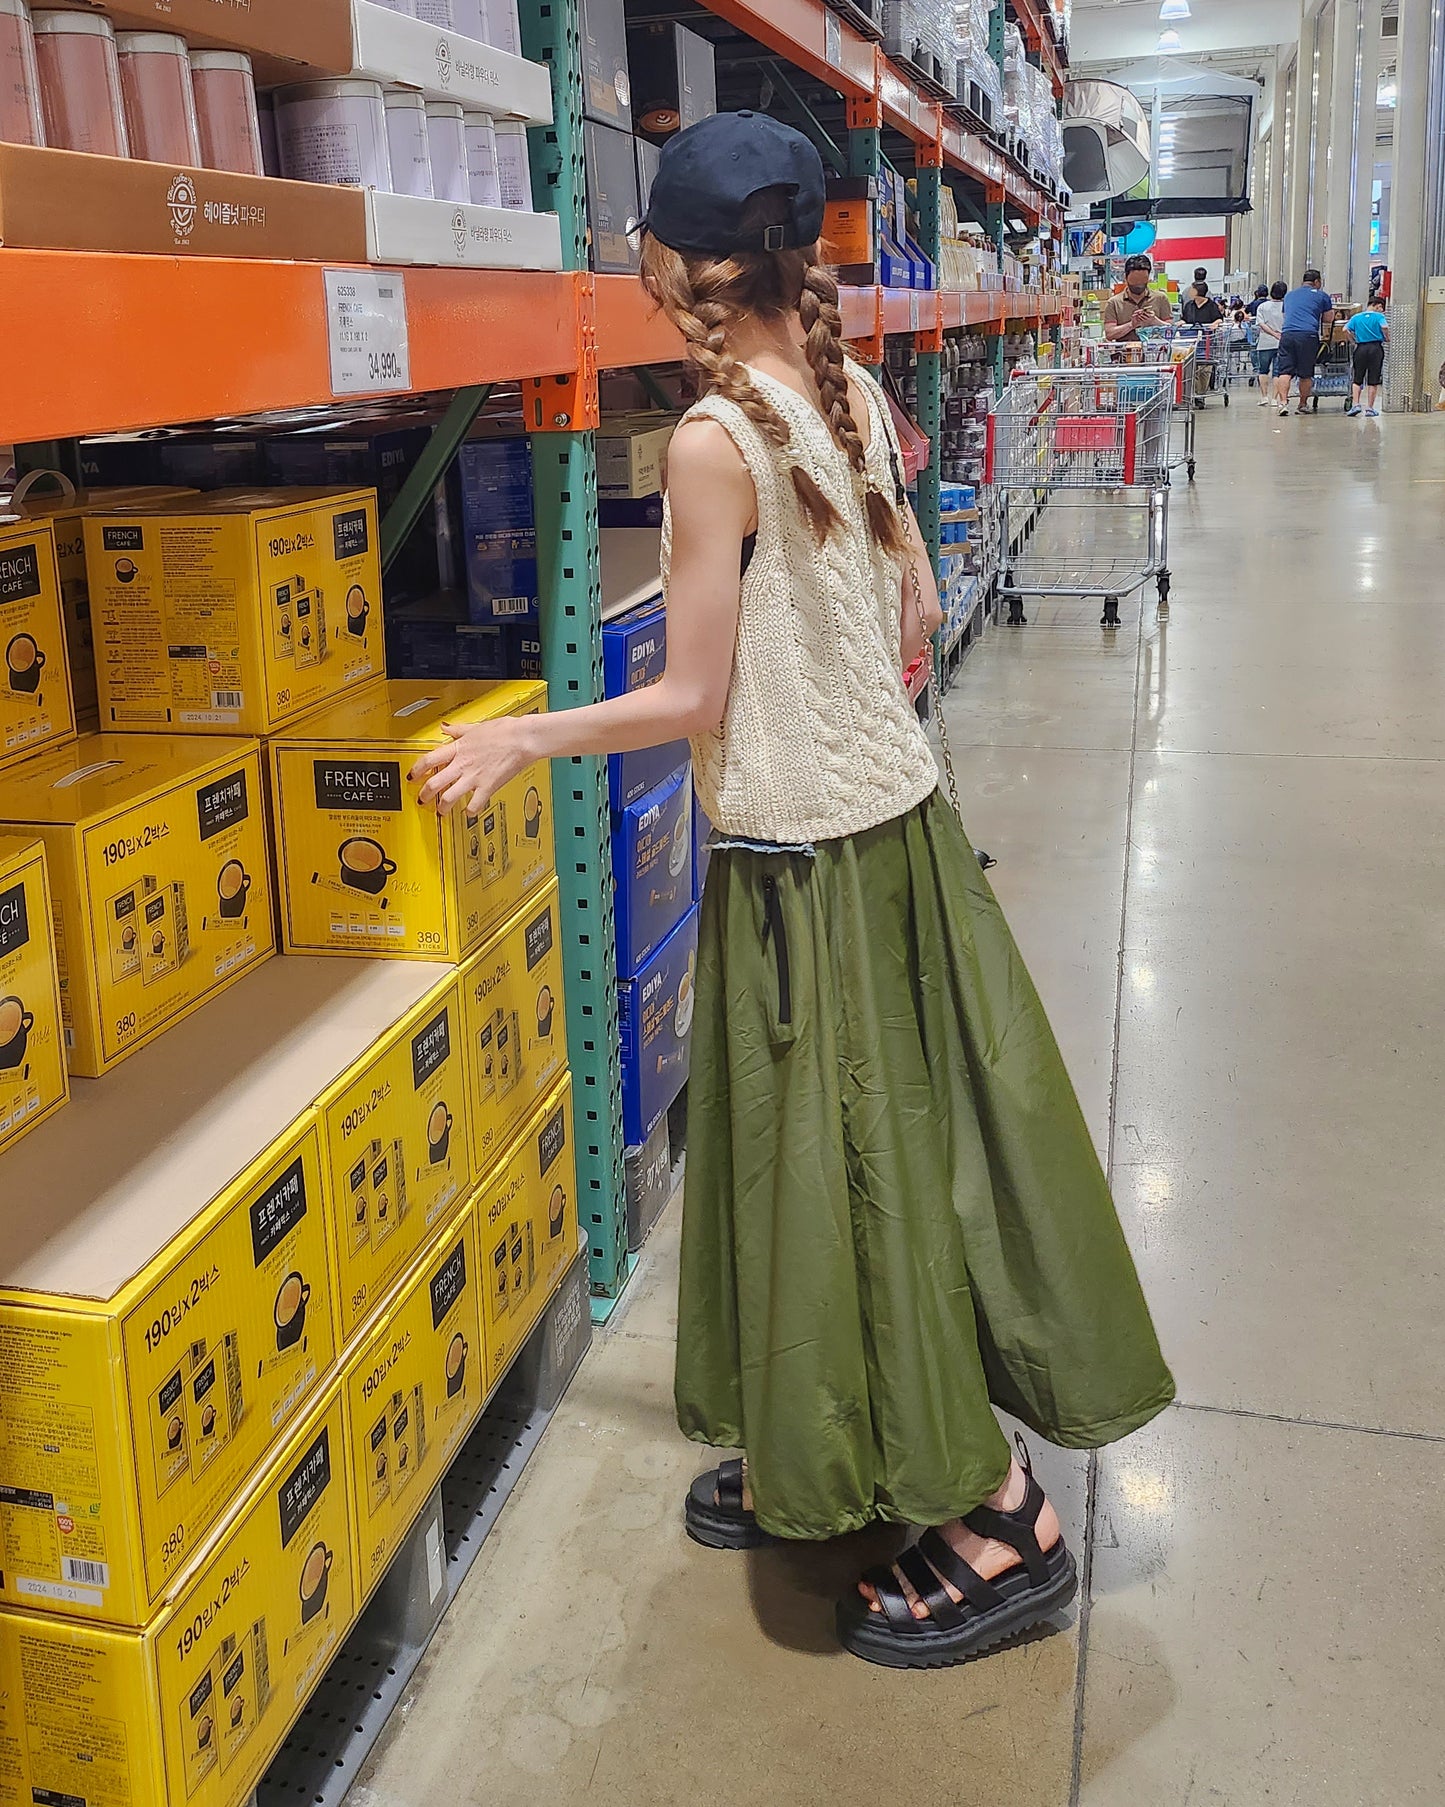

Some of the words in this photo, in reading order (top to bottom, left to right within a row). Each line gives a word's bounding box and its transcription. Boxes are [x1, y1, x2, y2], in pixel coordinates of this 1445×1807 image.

[203, 201, 240, 225] 헤이즐넛
[240, 205, 266, 227] 파우더
[108, 530, 138, 540] FRENCH
[269, 534, 315, 558] 190입x2박스
[2, 577, 22, 594] CAFÉ
[632, 638, 655, 663] EDIYA
[276, 688, 290, 706] 380
[324, 770, 390, 788] FRENCH
[204, 781, 241, 813] 프렌치카페
[343, 788, 374, 801] CAFÉ
[638, 804, 660, 832] EDIYA
[102, 822, 170, 867] 190입x2박스
[467, 911, 478, 931] 380
[417, 932, 440, 944] 380
[474, 960, 512, 1005] 190입x2박스
[642, 971, 662, 1003] EDIYA
[116, 1012, 136, 1036] 380
[117, 1029, 136, 1045] STICKS
[416, 1020, 445, 1061] 프렌치카페
[340, 1080, 392, 1141] 190입x2박스
[541, 1116, 562, 1154] FRENCH
[258, 1173, 299, 1231] 프렌치카페
[488, 1172, 526, 1227] 190입x2박스
[270, 1212, 290, 1238] 카페믹스
[434, 1254, 462, 1302] FRENCH
[352, 1284, 366, 1312] 380
[443, 1280, 456, 1306] CAFÉ
[144, 1264, 220, 1354] 190입x2박스
[195, 1367, 213, 1391] FRENCH
[362, 1330, 412, 1403] 190입x2박스
[160, 1378, 180, 1403] FRENCH
[286, 1444, 324, 1512] 프렌치카페
[162, 1523, 184, 1564] 380
[370, 1538, 386, 1570] 380
[164, 1544, 186, 1574] STICKS
[176, 1557, 250, 1662] 190입x2박스
